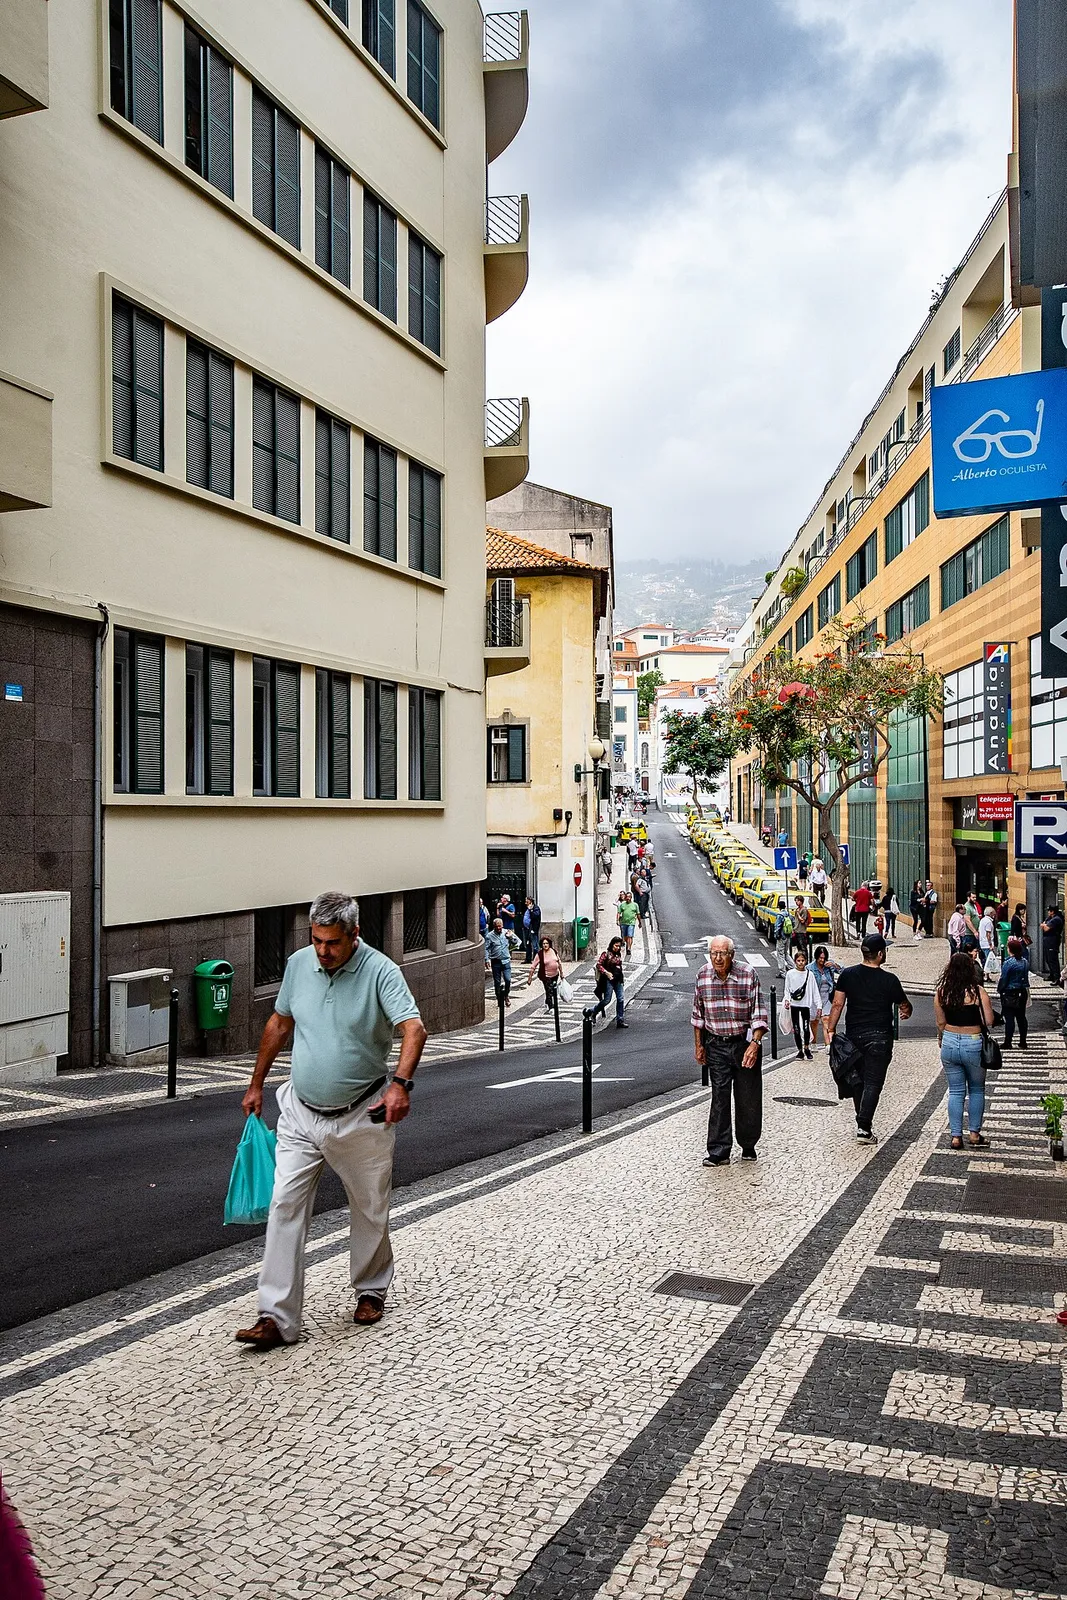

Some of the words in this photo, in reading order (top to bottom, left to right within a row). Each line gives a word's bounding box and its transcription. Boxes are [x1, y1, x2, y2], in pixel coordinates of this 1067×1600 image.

[952, 468, 997, 481] Alberto
[1000, 464, 1047, 475] OCULISTA
[986, 667, 999, 771] Anadia
[614, 742, 623, 763] SIAM
[980, 796, 1011, 804] telepizza
[1021, 806, 1067, 853] P
